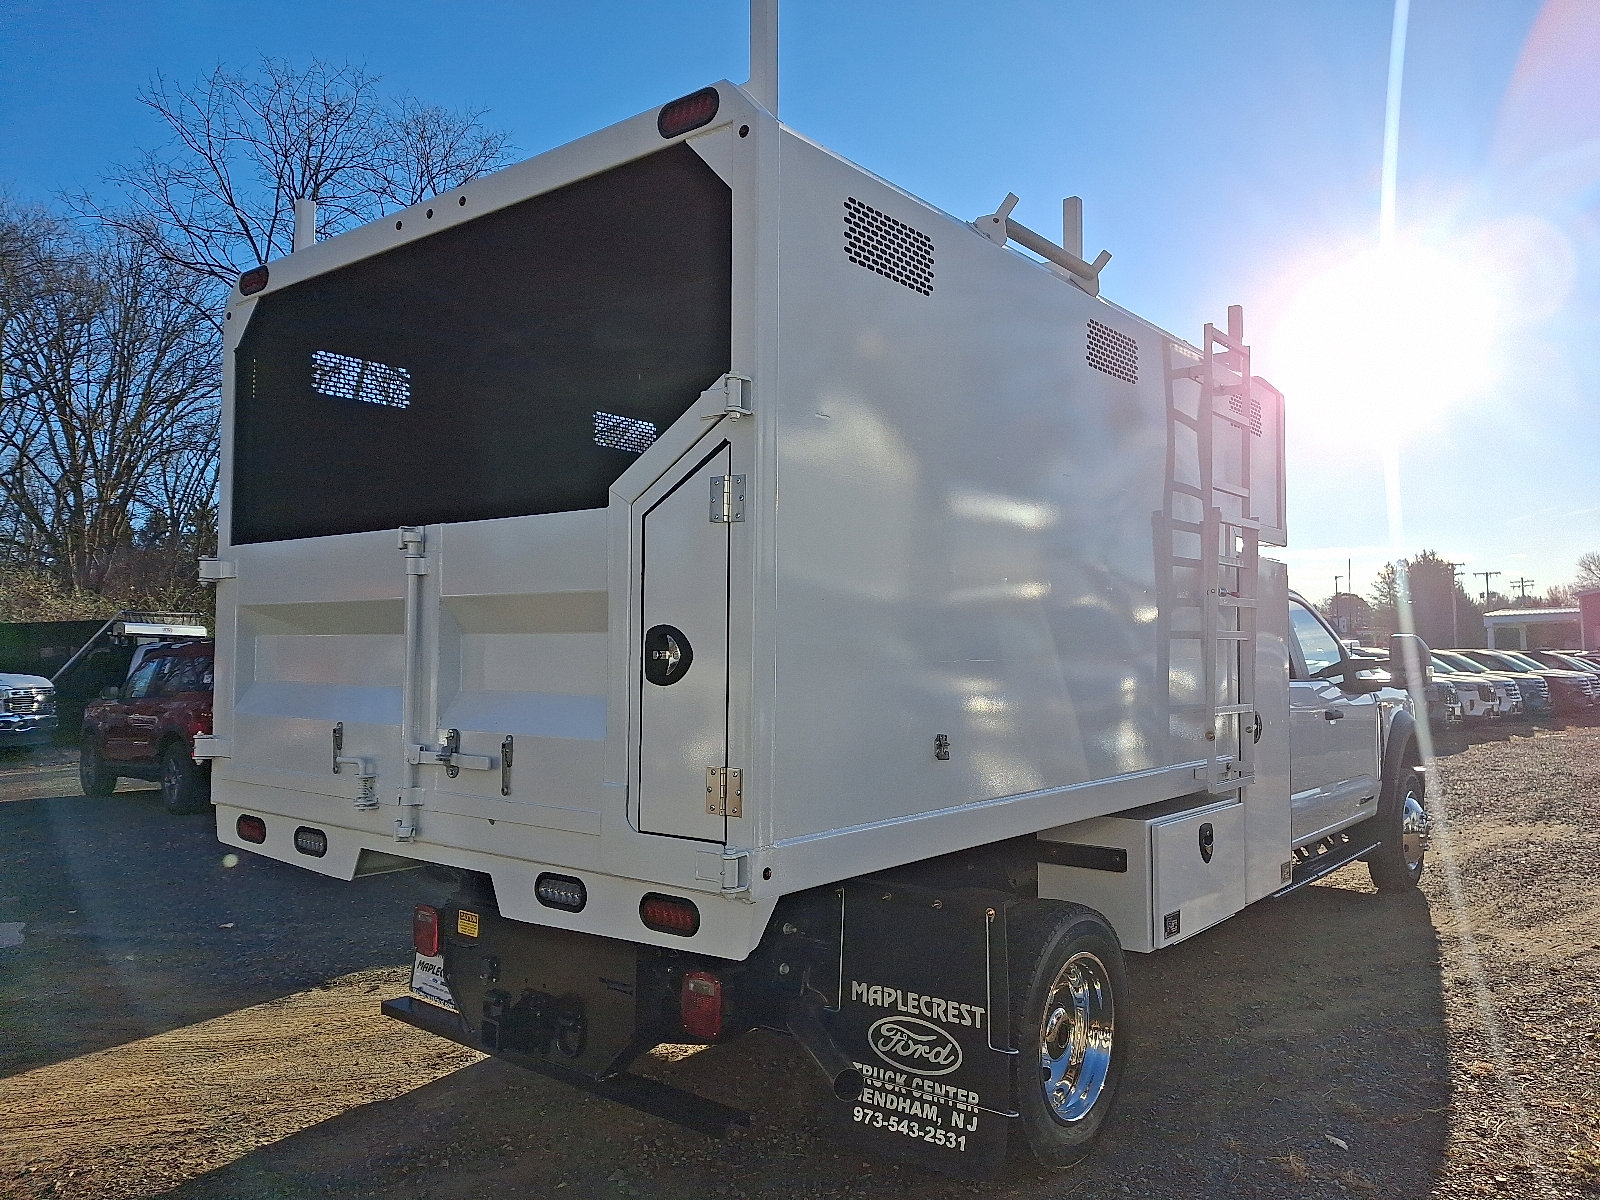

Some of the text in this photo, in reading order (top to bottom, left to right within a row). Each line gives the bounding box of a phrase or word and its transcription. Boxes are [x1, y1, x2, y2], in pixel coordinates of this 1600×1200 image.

[851, 980, 986, 1029] MAPLECREST
[877, 1023, 955, 1065] Ford
[858, 1087, 942, 1126] ENDHAM,
[912, 1077, 979, 1114] CENTER
[853, 1106, 966, 1152] 973-543-2531
